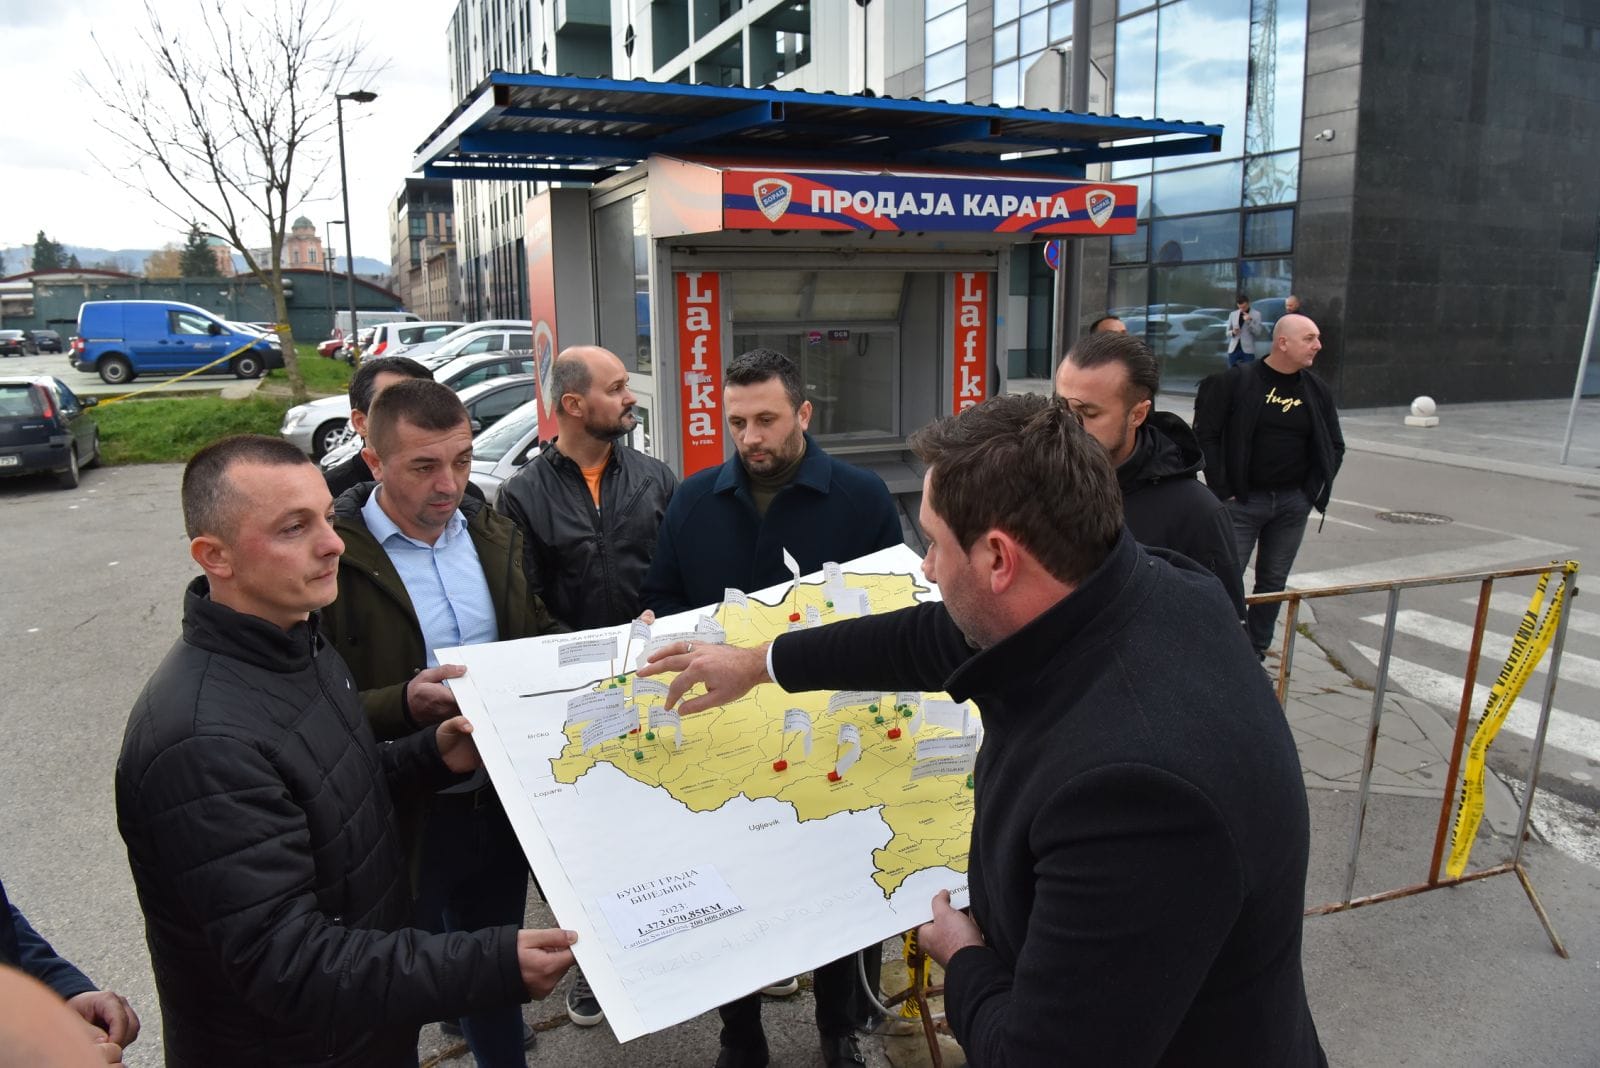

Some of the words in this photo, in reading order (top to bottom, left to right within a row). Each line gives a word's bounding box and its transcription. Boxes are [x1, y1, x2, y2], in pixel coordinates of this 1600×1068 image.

[811, 189, 956, 219] ПРОДАЈА
[963, 193, 1071, 218] КАРАТА
[685, 272, 716, 437] Lafka
[748, 818, 780, 831] Ugljevik
